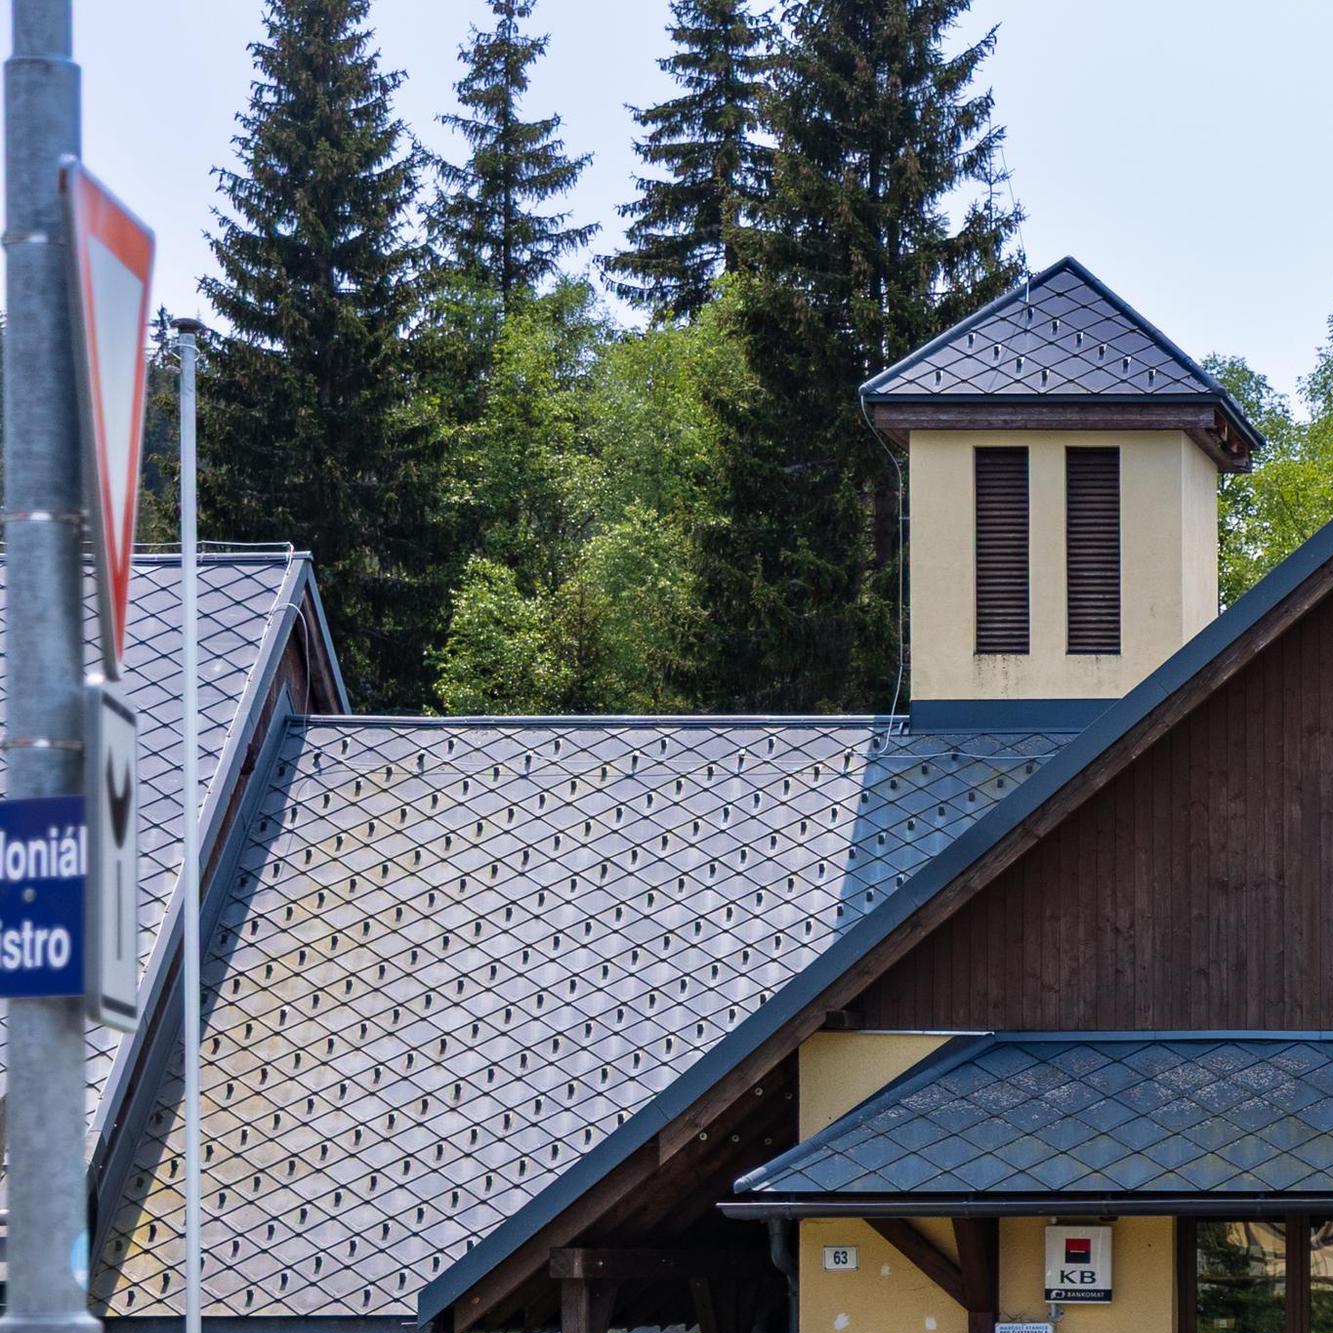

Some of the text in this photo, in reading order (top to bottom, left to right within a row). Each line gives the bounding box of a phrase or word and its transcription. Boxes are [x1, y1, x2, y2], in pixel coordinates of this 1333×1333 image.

[0, 919, 72, 970] stro
[834, 1251, 848, 1264] 63
[1060, 1270, 1096, 1284] KB
